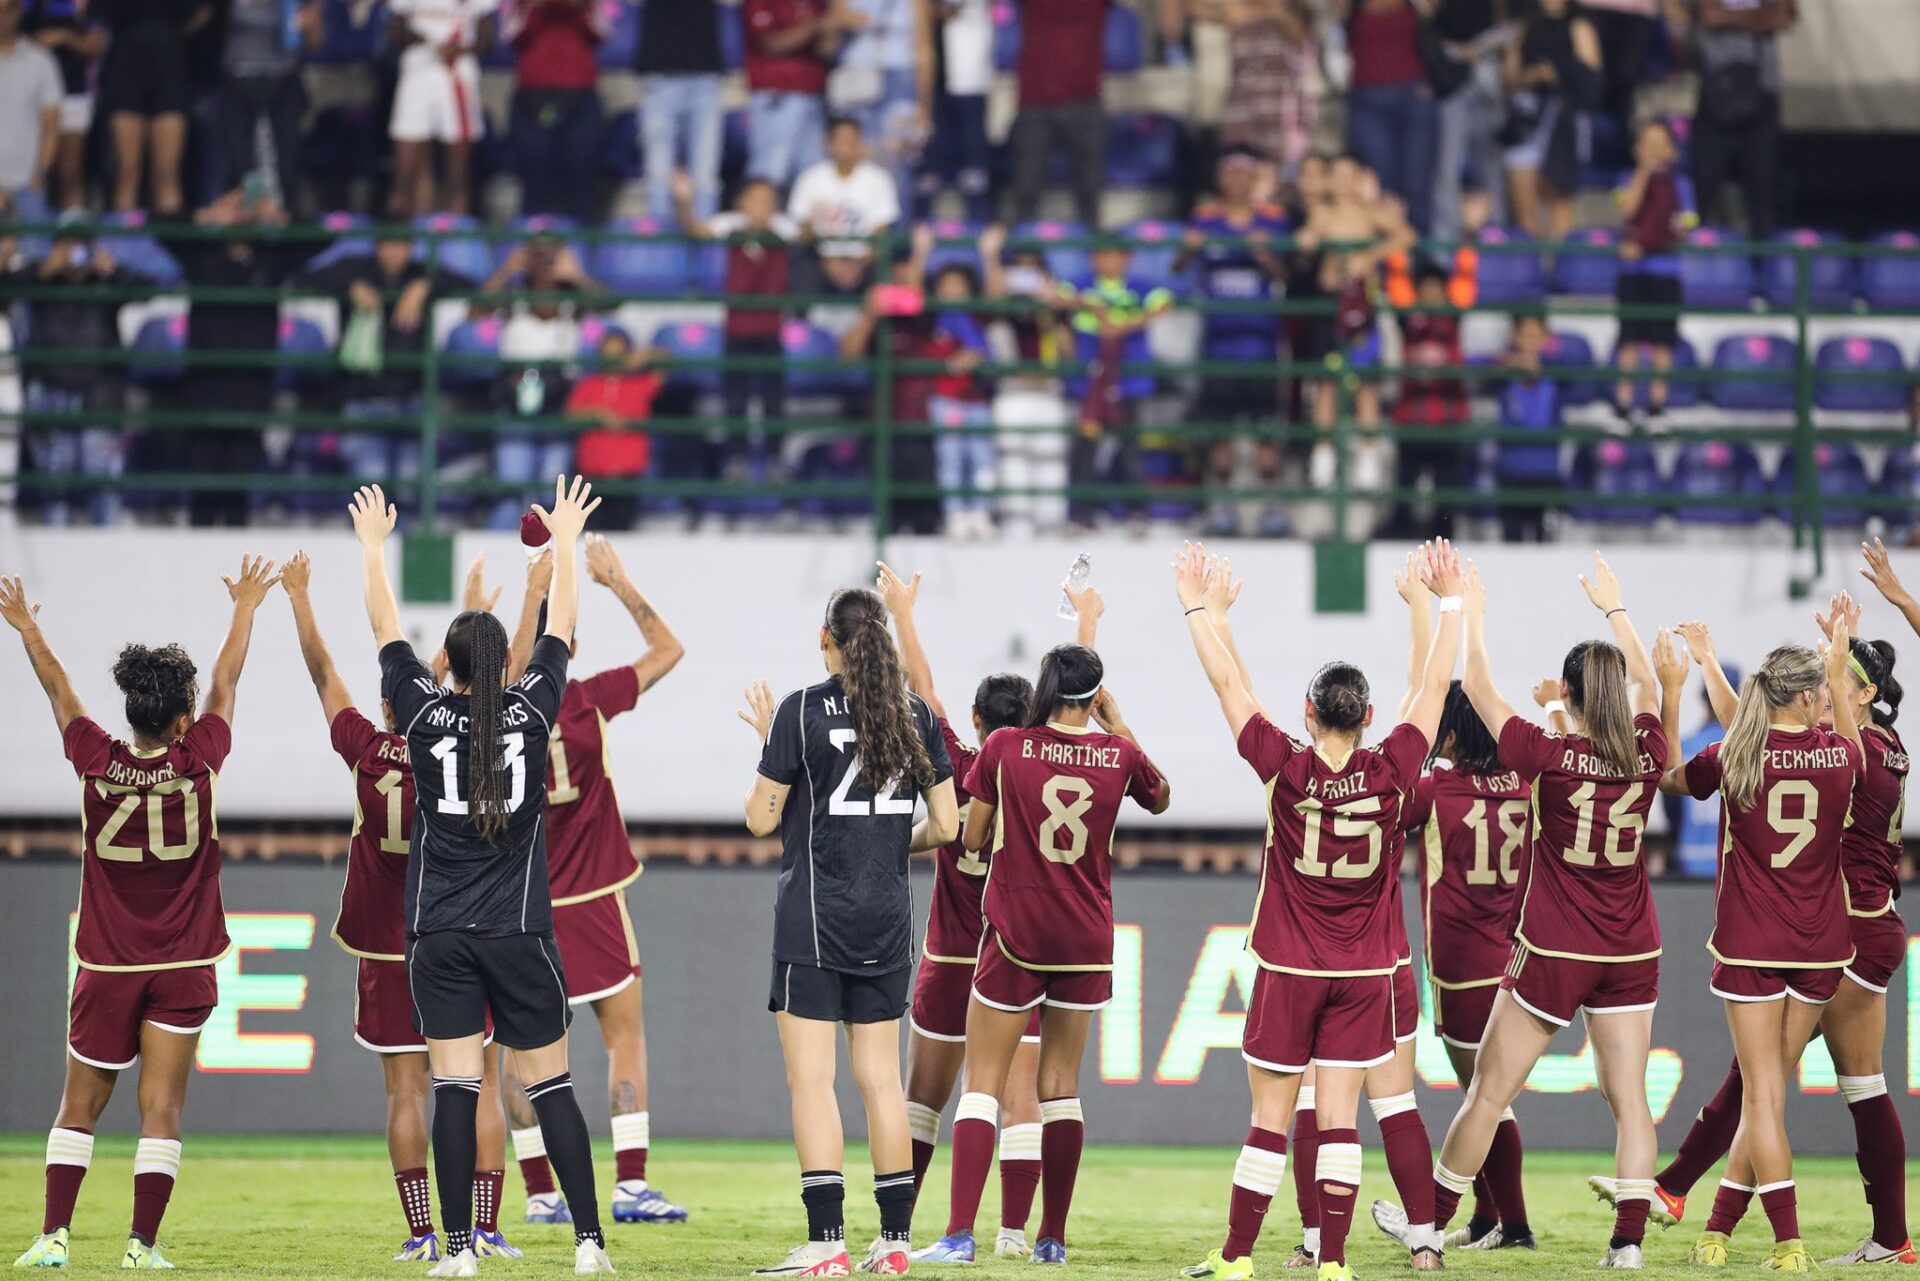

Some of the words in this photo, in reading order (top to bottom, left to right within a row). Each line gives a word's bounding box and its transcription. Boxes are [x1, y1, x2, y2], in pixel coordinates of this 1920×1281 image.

[427, 705, 456, 728] NAY
[1021, 738, 1036, 759] B.
[1040, 743, 1121, 769] MARTÍNEZ
[1561, 748, 1575, 771] A.
[94, 777, 200, 862] 20
[1039, 774, 1094, 865] 8
[1293, 795, 1382, 878] 15
[1462, 799, 1530, 885] 18
[1563, 781, 1645, 867] 16
[1767, 779, 1819, 869] 9
